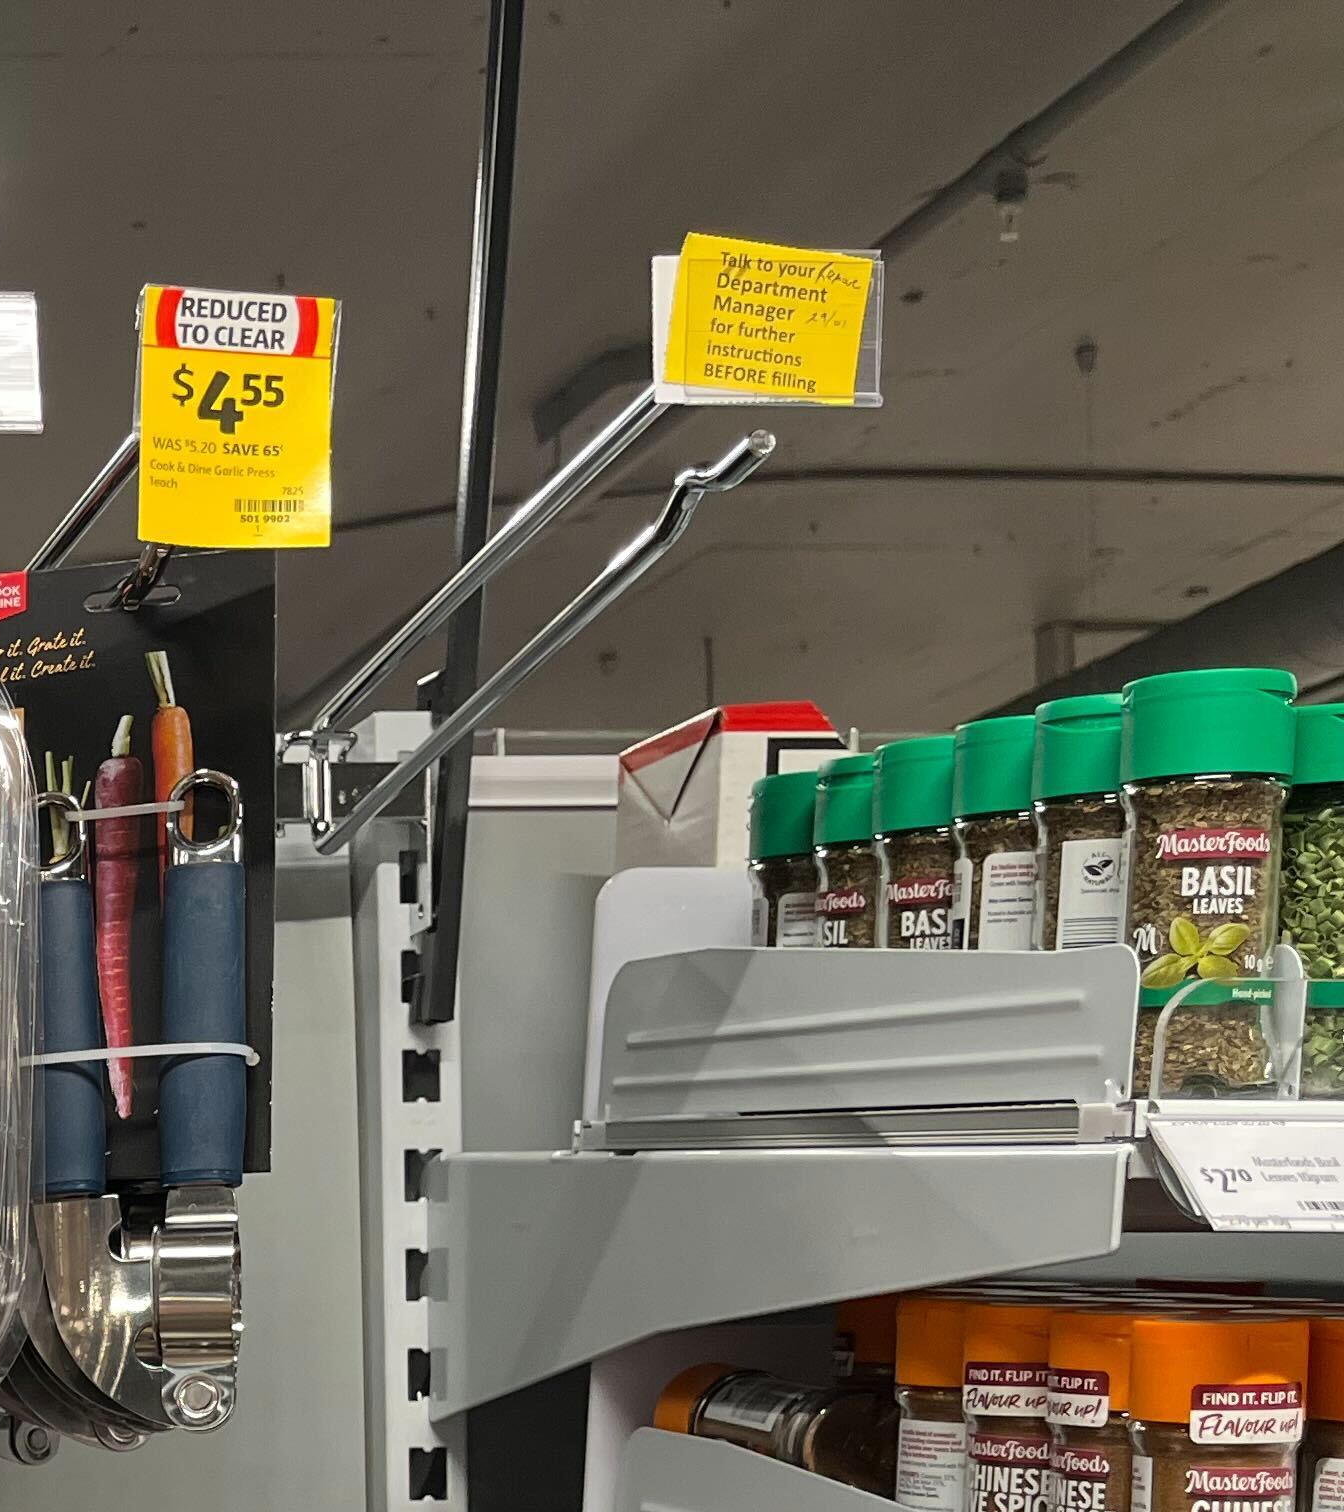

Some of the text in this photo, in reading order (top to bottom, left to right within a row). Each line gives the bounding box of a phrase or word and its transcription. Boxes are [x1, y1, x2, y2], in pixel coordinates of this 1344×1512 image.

[721, 252, 752, 269] Talk
[757, 259, 773, 272] to
[779, 264, 815, 279] your
[716, 273, 827, 303] Department
[181, 297, 287, 324] REDUCED
[713, 295, 795, 322] Manager
[179, 324, 286, 350] TO CLEAR
[710, 318, 796, 343] for further
[707, 340, 802, 367] instructions
[704, 363, 816, 393] BEFORE filling
[1156, 831, 1271, 860] MasterFoods
[1181, 866, 1255, 897] BASIL
[1193, 896, 1244, 915] LEAVES
[1202, 1391, 1286, 1407] FIND IT. FLIP
[1185, 1470, 1293, 1496] MasterFoods
